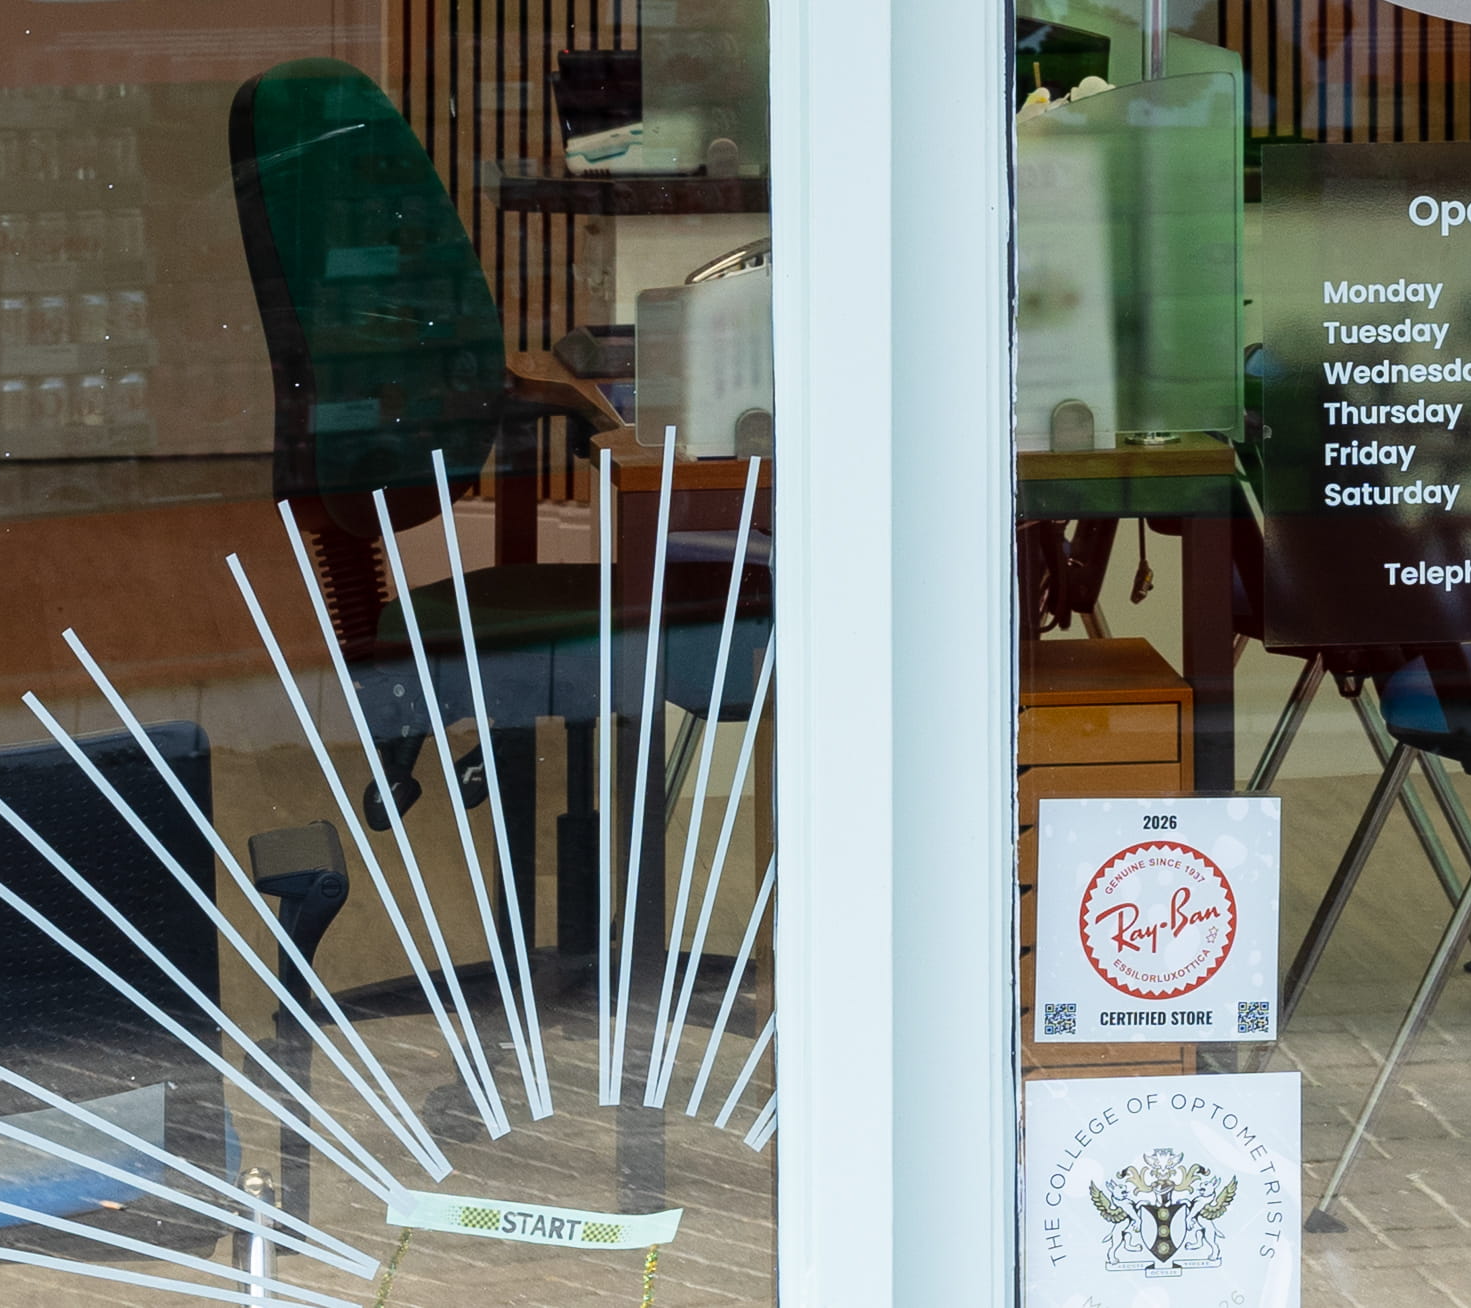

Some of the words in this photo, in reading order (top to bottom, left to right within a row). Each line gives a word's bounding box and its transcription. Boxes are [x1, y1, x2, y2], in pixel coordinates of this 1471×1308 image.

[1323, 278, 1444, 310] Monday
[1322, 318, 1450, 350] Tuesday
[1323, 398, 1463, 430] Thursday
[1325, 439, 1417, 472] Friday
[1324, 479, 1461, 511] Saturday
[1143, 815, 1178, 830] 2026
[1104, 859, 1147, 895] GENUINE
[1149, 858, 1182, 869] SINCE
[1100, 1011, 1167, 1026] CERTIFIED
[1170, 1010, 1213, 1026] STORE
[1127, 1093, 1159, 1115] OF
[1045, 1106, 1120, 1207] COLLEGE
[1170, 1093, 1283, 1260] OPTOMETRISTS
[500, 1210, 583, 1241] START
[1044, 1217, 1067, 1267] THE
